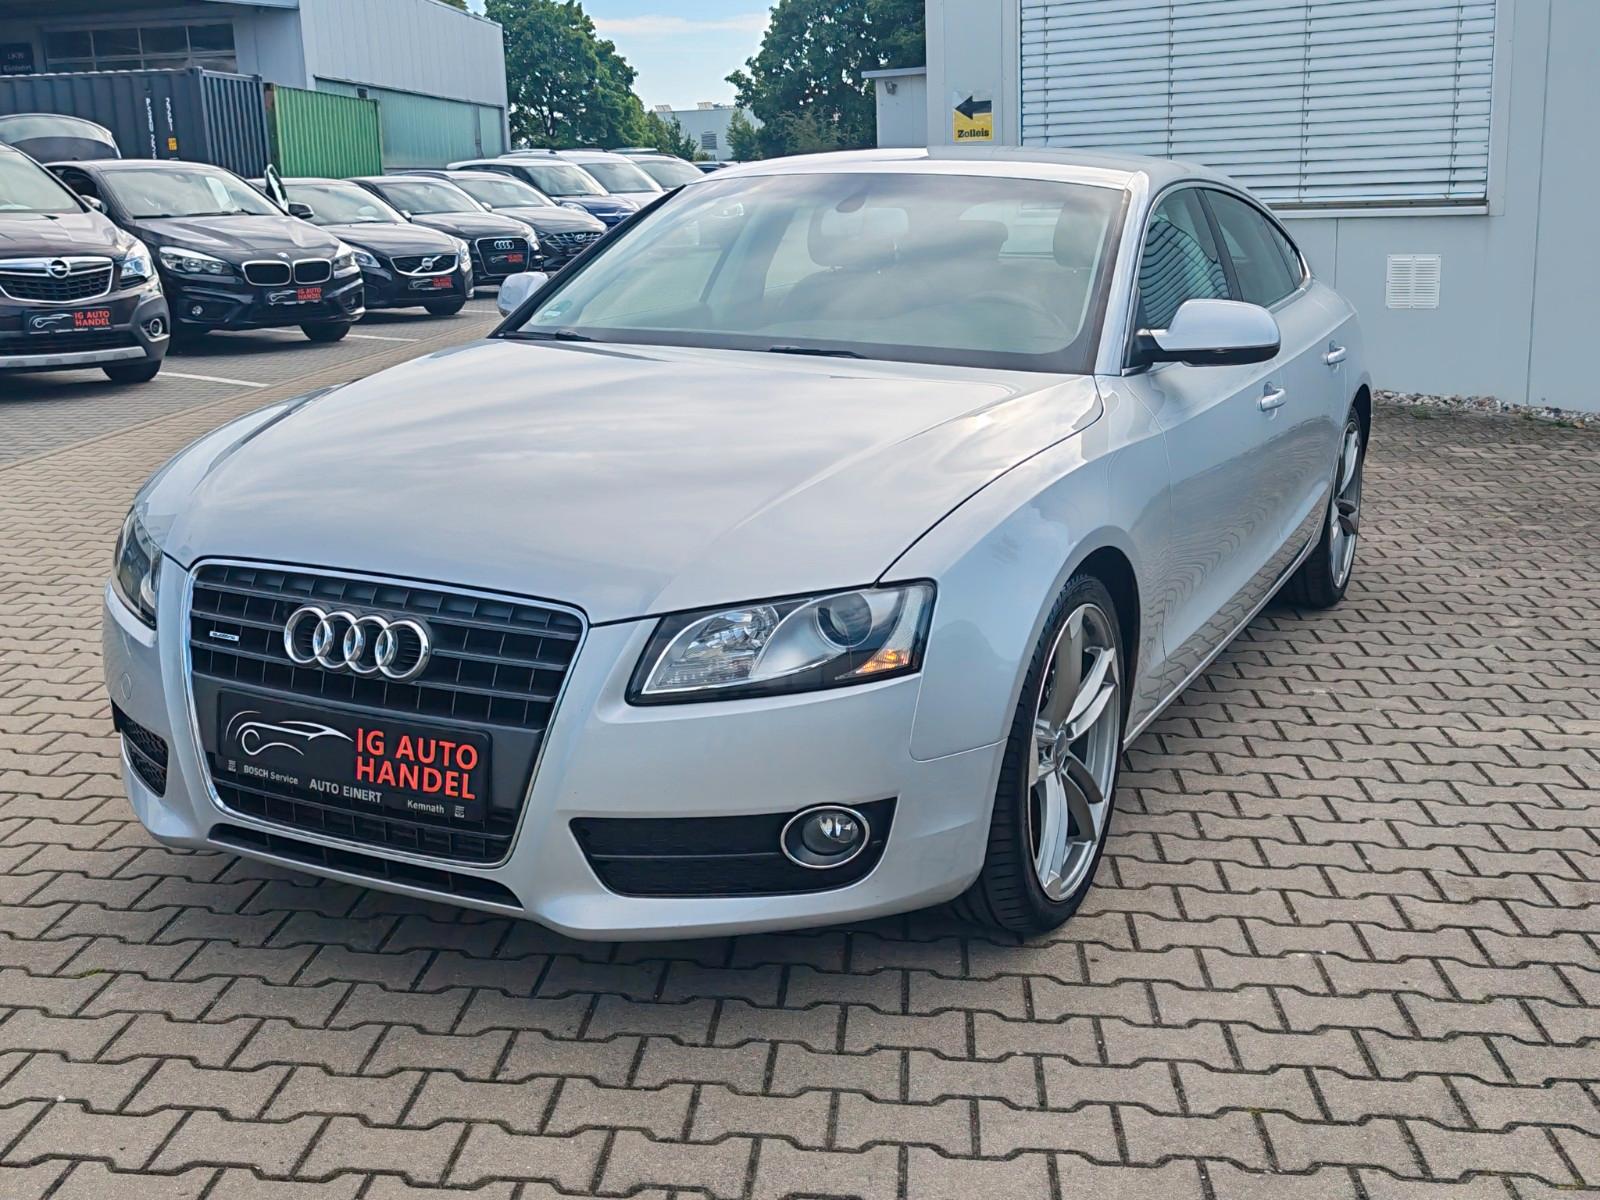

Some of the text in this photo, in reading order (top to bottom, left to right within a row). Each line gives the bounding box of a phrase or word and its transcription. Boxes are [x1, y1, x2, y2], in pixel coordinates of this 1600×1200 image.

[957, 128, 990, 138] Zolleis
[74, 310, 110, 320] IG AUTO
[75, 318, 110, 327] HANDEL
[357, 728, 478, 770] IG AUTO
[243, 765, 445, 814] BOSCH Service AUTO EINERT Kemnath
[356, 756, 476, 800] HANDEL
